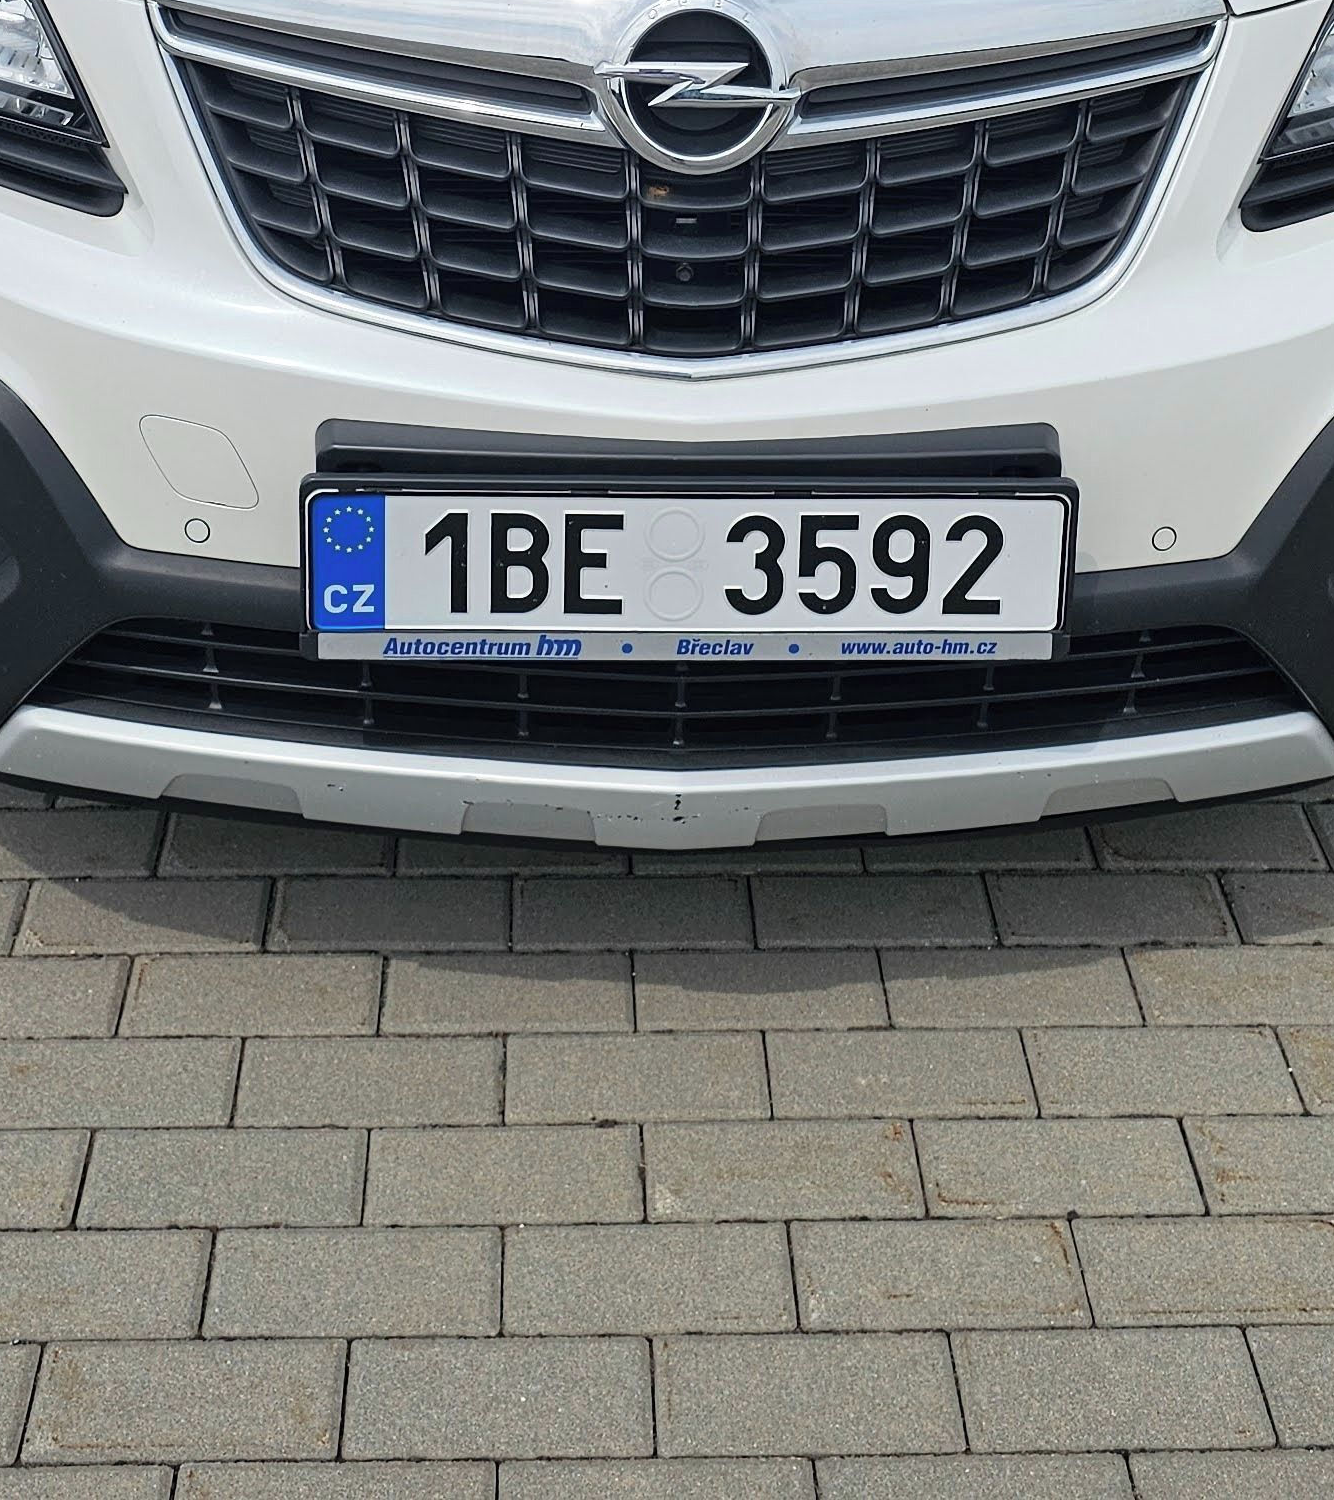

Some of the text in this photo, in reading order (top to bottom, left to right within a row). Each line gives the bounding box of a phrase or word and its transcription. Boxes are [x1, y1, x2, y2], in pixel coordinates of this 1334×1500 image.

[424, 512, 1004, 616] 1BE 3592
[323, 583, 375, 614] CZ
[383, 634, 582, 657] Autocentrum hm
[676, 638, 754, 656] Břeclav
[840, 638, 998, 656] www.auto-hm.cz
